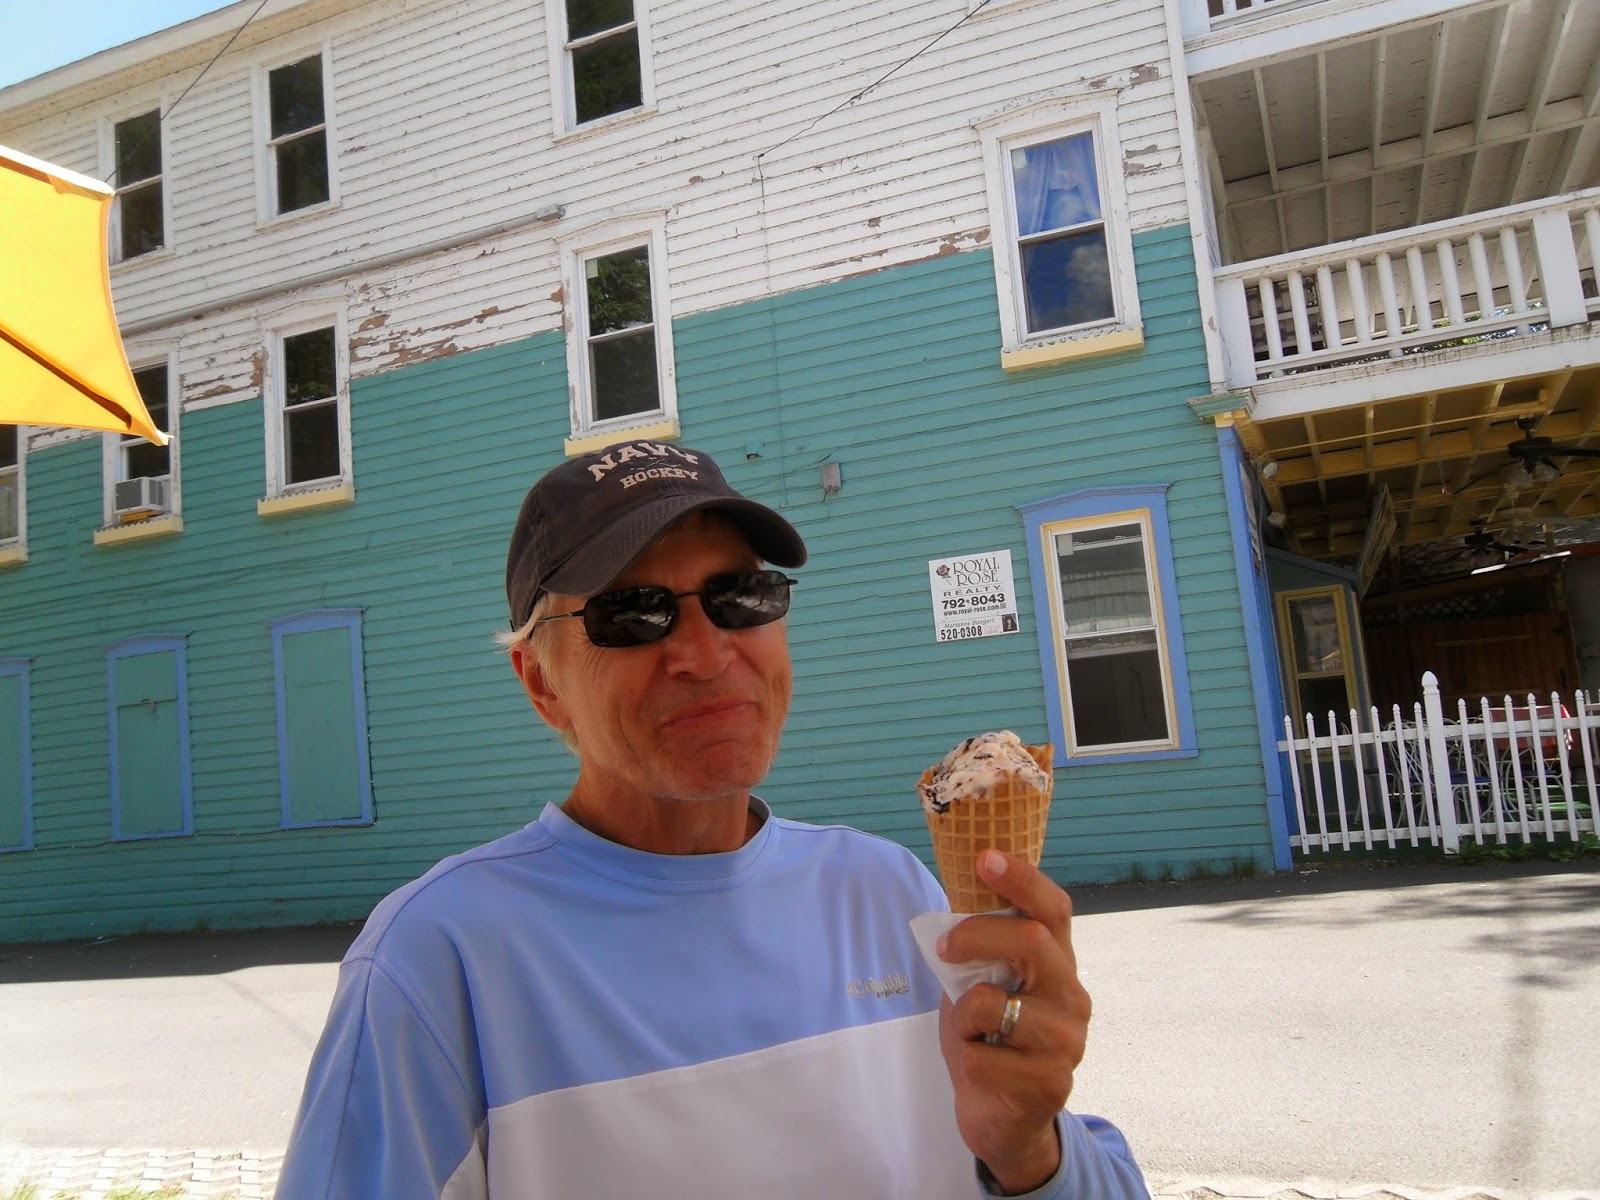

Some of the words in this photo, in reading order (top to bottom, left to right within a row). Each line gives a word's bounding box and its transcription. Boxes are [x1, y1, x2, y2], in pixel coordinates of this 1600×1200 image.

[587, 442, 698, 482] NAVY
[620, 467, 698, 488] HOCKEY
[952, 557, 999, 575] ROYAL
[956, 569, 998, 587] ROSE
[943, 584, 1001, 597] REALTY
[943, 604, 999, 617] www.royal-rose.com
[940, 625, 983, 640] 520-0308
[944, 620, 971, 629] Marianne
